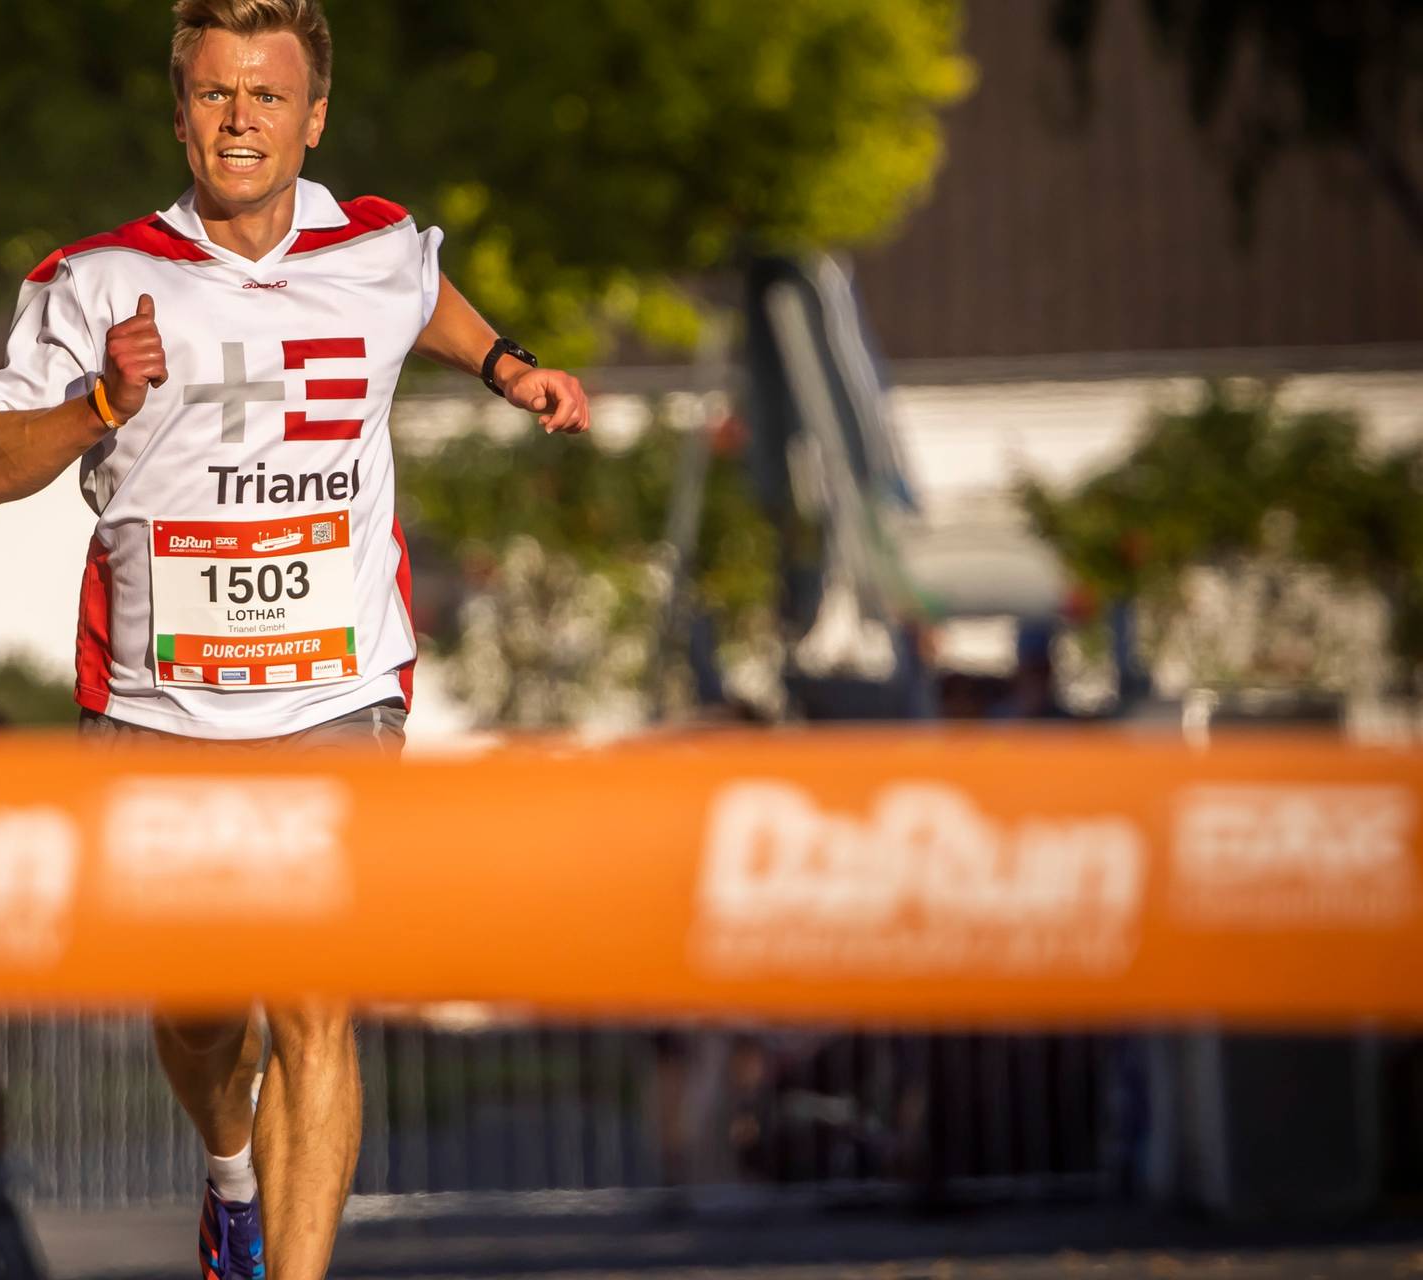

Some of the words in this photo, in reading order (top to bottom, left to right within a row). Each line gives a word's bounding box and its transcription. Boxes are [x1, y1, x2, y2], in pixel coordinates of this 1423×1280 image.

[208, 458, 360, 505] Trianel
[200, 560, 311, 605] 1503
[227, 607, 285, 621] LOTHAR
[228, 624, 257, 633] Trianel
[259, 623, 285, 632] GmbH
[202, 638, 321, 658] DURCHSTARTER
